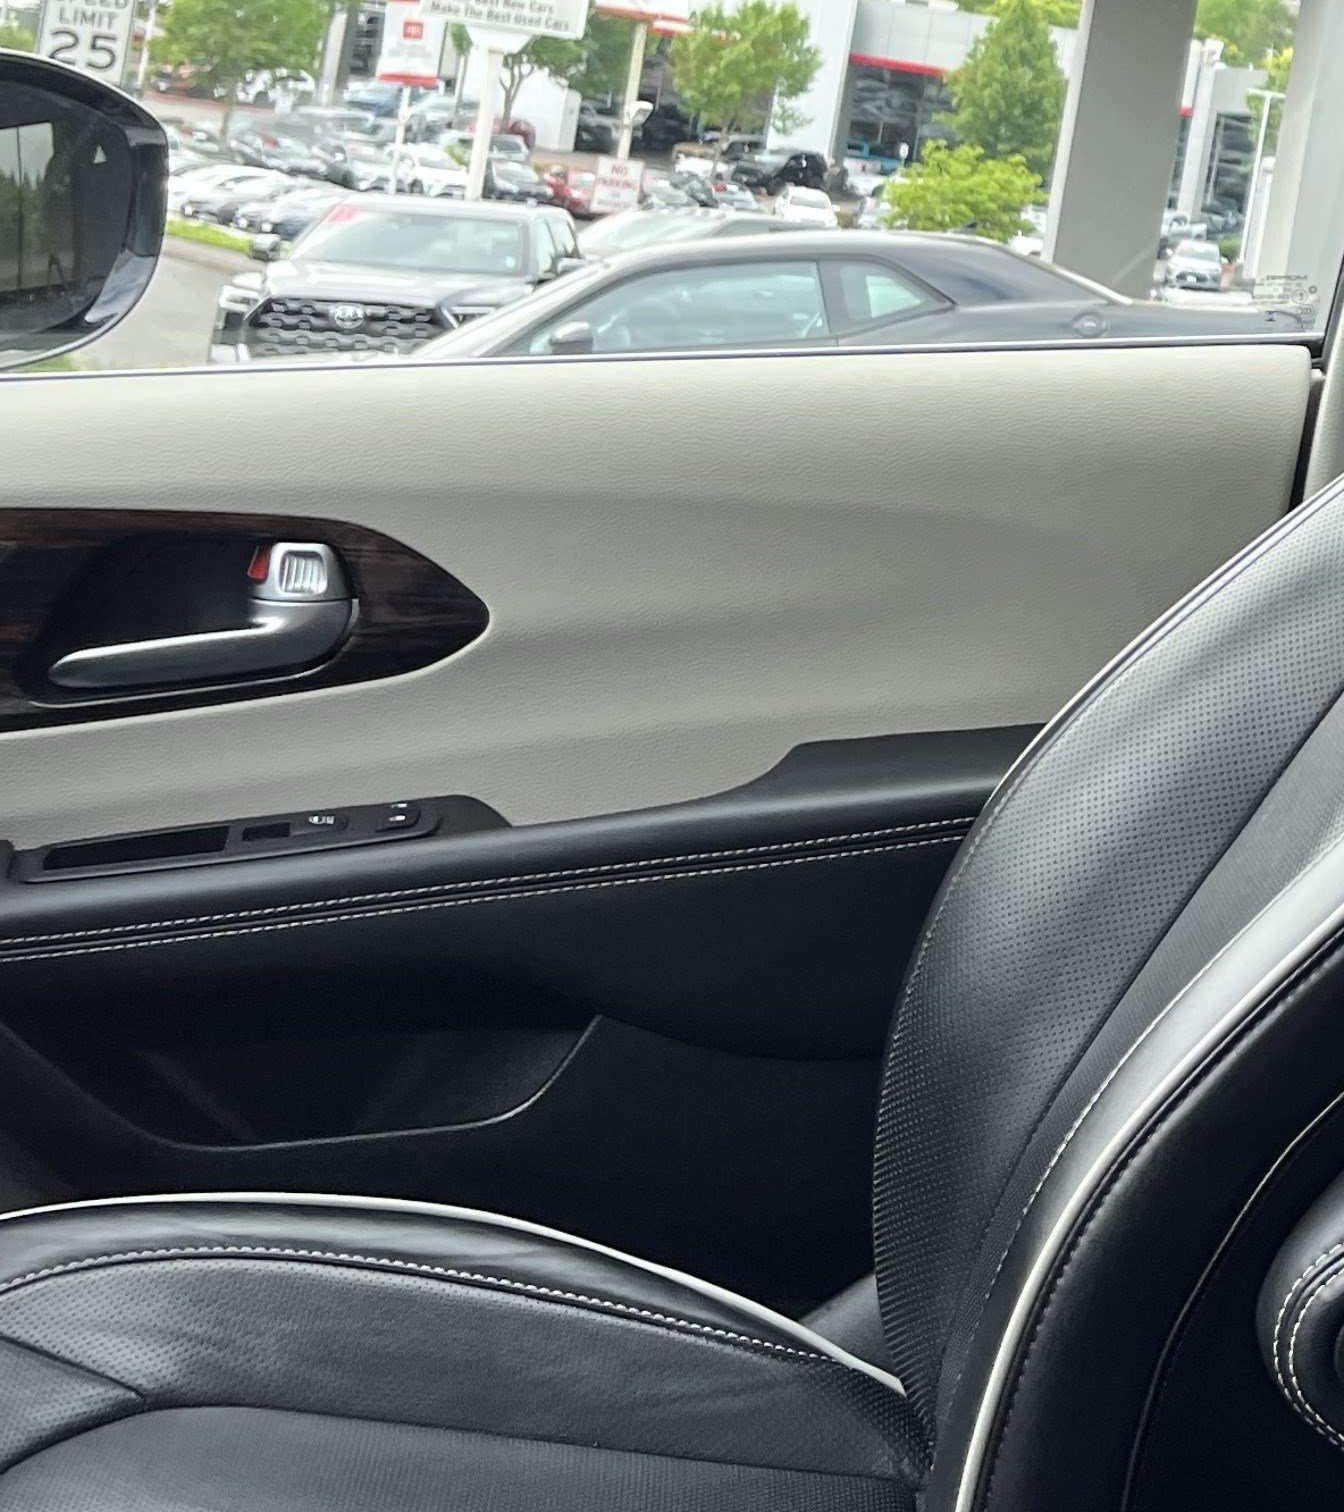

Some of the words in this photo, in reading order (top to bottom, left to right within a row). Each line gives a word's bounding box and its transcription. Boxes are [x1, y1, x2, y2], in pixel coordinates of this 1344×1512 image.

[59, 7, 118, 29] LIMIT
[431, 0, 460, 13] Make
[464, 4, 483, 18] The
[487, 9, 511, 22] Best
[514, 14, 541, 27] Used
[545, 16, 569, 31] Cars
[529, 0, 554, 14] Cars
[49, 30, 117, 70] 25
